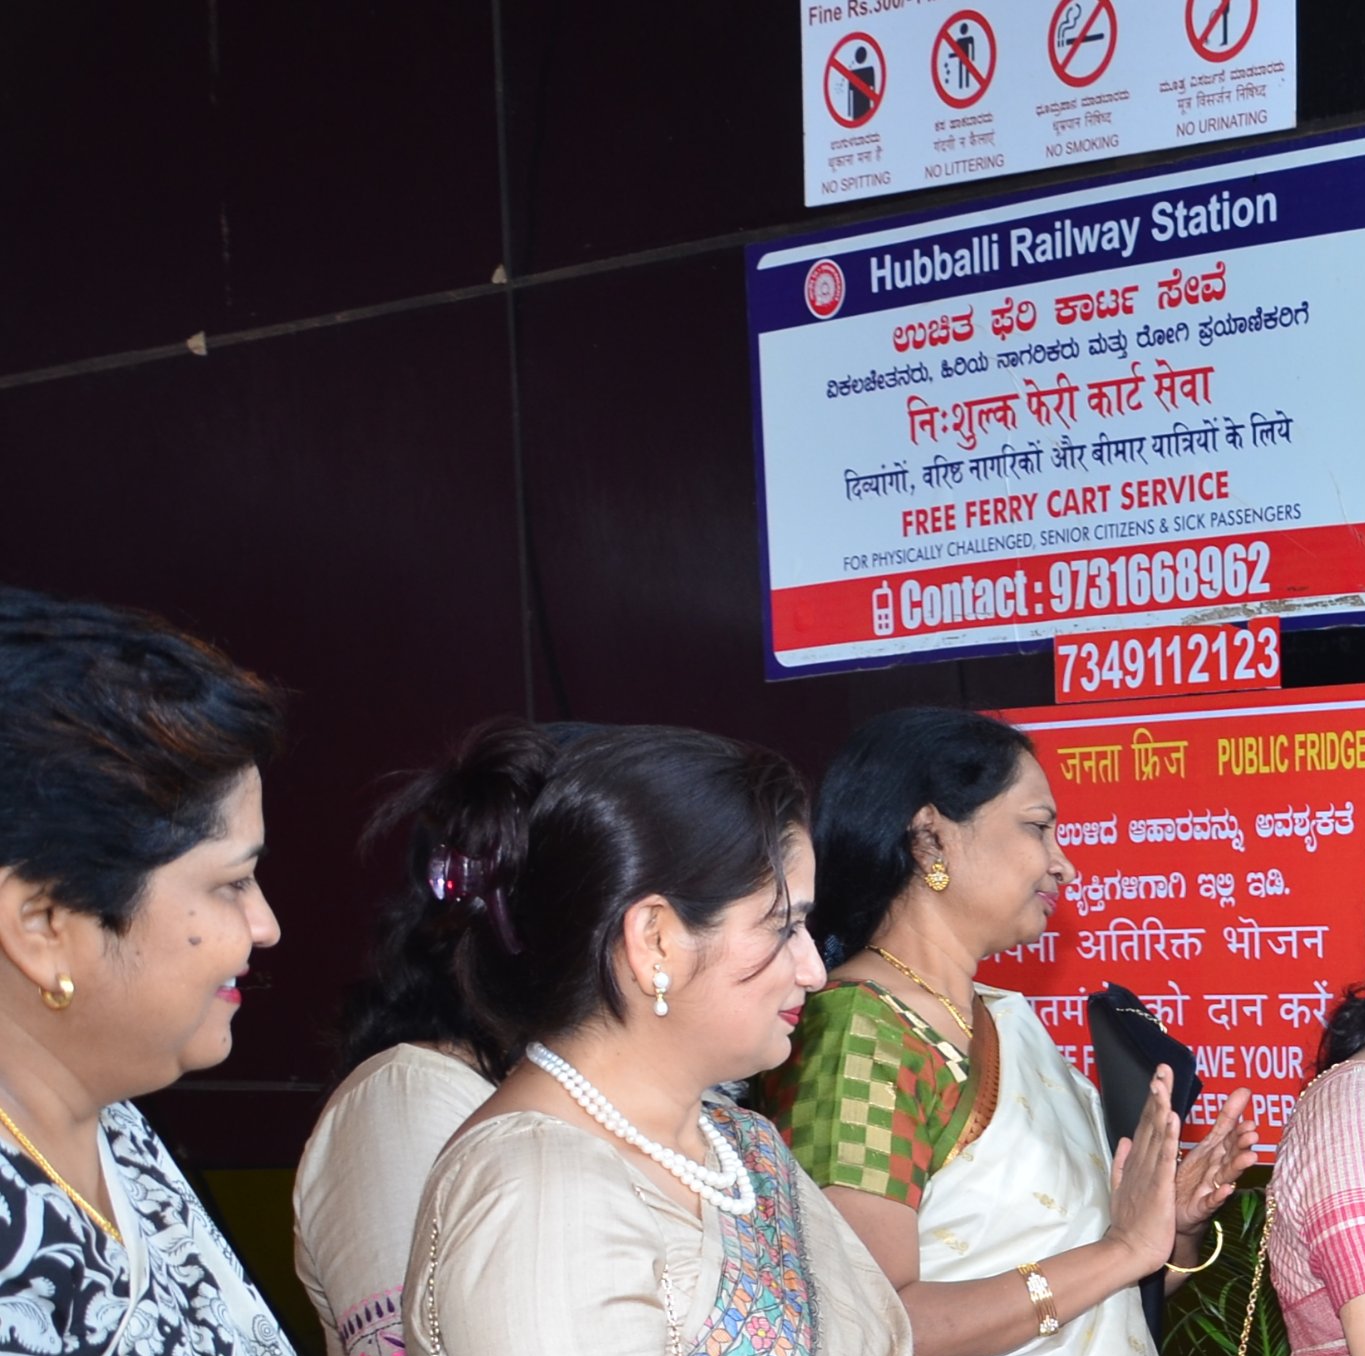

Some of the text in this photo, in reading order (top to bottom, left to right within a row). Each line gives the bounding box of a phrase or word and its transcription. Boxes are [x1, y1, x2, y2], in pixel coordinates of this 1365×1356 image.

[808, 6, 842, 26] Fine
[1045, 134, 1120, 158] NO SMOKING
[1176, 110, 1268, 137] NO URINATING
[821, 171, 892, 194] NO SPITTING
[925, 154, 1005, 179] NO LITTERING
[870, 233, 1000, 293] Hubballi
[1010, 216, 1140, 267] Railway
[1151, 191, 1277, 242] Station
[893, 304, 975, 353] ಉಚಿತ
[1157, 261, 1227, 310] ಸೇವೆ
[941, 351, 989, 379] ಹಿರಿಯ
[996, 337, 1080, 369] ನಾಗರಿಕರು
[1088, 329, 1128, 359] ಮತ್ತು
[1136, 322, 1190, 348] ರೋಗಿ
[1023, 372, 1080, 429] फेरी
[1087, 361, 1146, 418] कार्ट
[1153, 358, 1215, 413] सेवा
[922, 455, 965, 489] वरिष्ठ
[969, 440, 1044, 480] नागरिकों
[1050, 434, 1089, 472] और
[1091, 432, 1149, 465] बीमार
[1151, 417, 1219, 458] यात्रियों
[1223, 416, 1245, 450] के
[1250, 410, 1293, 447] लिये
[902, 471, 1230, 538] FREE FERRY CART SERVICE
[843, 503, 1302, 571] FOR PHYSICALLY CHALLENGED, SENIOR CITIZENS & SICK PASSENGERS
[900, 570, 1030, 630] Contact
[1049, 540, 1271, 614] 9731668962
[1057, 627, 1280, 693] 7349112123
[1057, 727, 1189, 785] जनता फ्रिज
[1217, 734, 1288, 776] PUBLIC
[1056, 801, 1355, 853] ಉಳಿದ ಆಹಾರವನ್ನು ಅವಶ್ಯಕತೆ
[1197, 871, 1236, 908] ಇಲ್ಲಿ
[1077, 916, 1206, 962] अतिरिक्त
[1203, 993, 1269, 1031] दान
[1278, 979, 1334, 1029] करें
[1188, 1045, 1304, 1079] AVE YOUR
